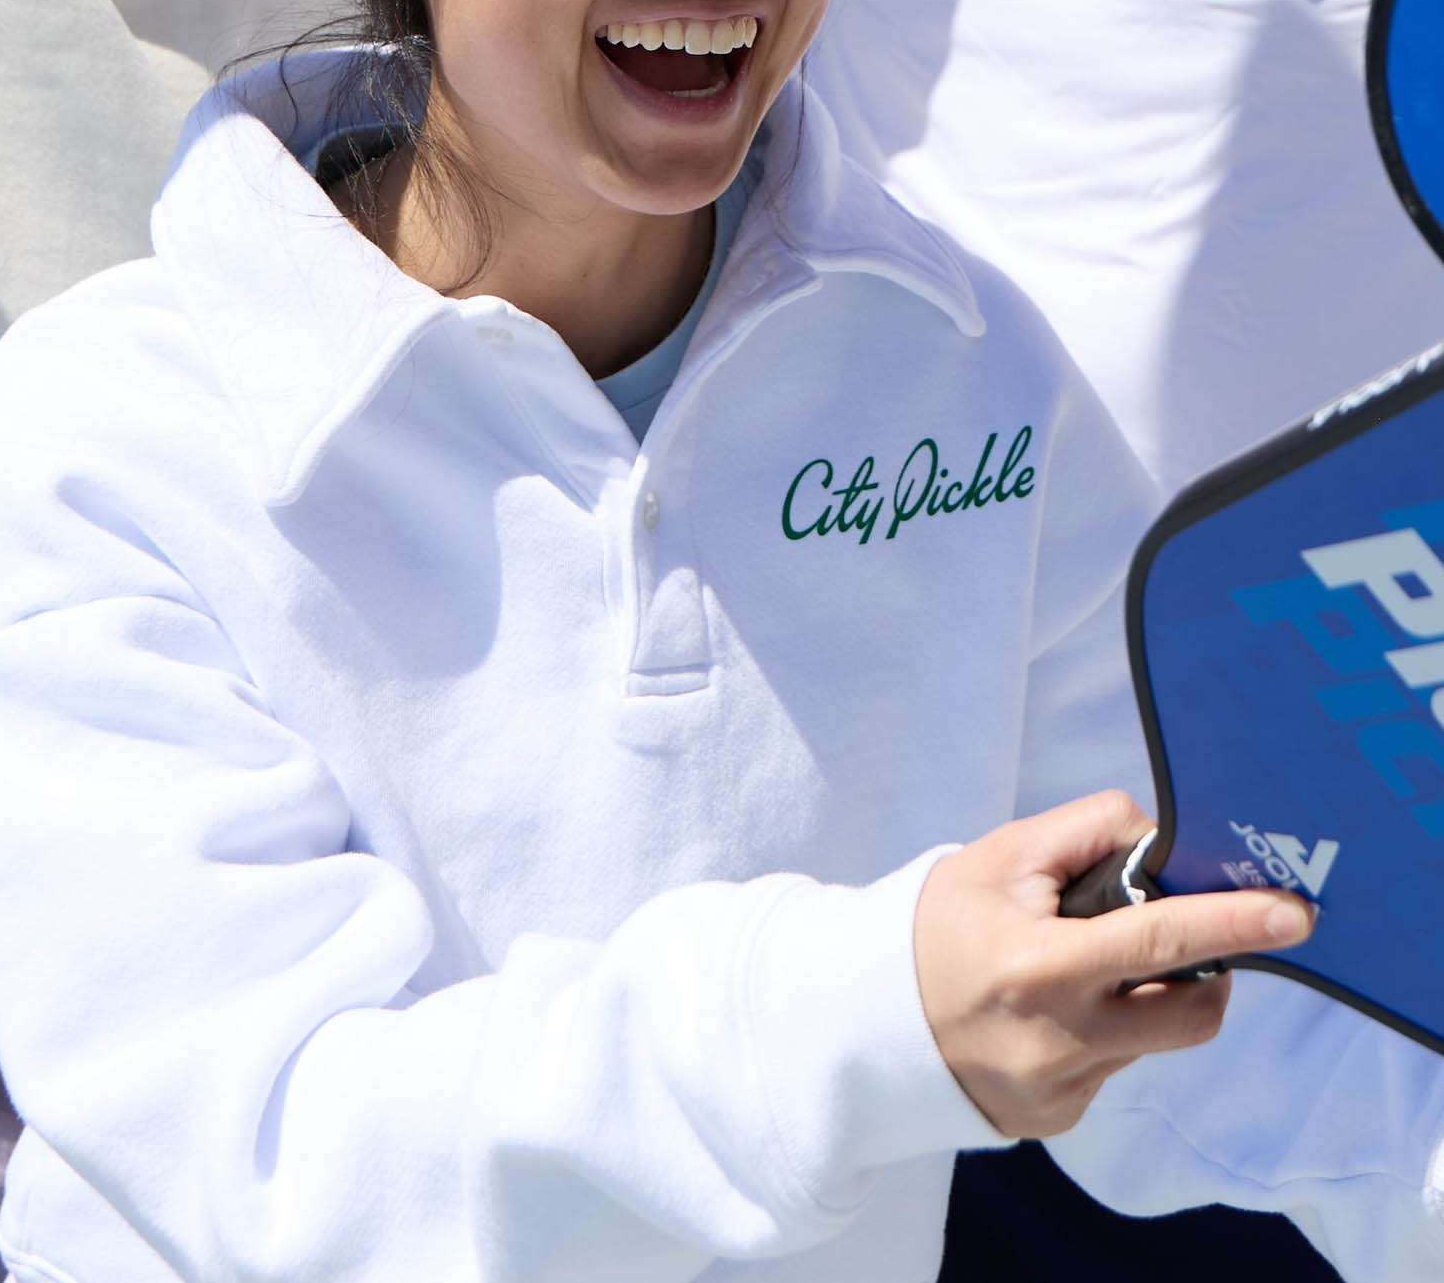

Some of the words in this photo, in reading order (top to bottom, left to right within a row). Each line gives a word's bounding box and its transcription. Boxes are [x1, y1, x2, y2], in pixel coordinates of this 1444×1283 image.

[781, 455, 884, 545] City
[885, 425, 1036, 540] Pickle
[1228, 819, 1308, 898] JOO
